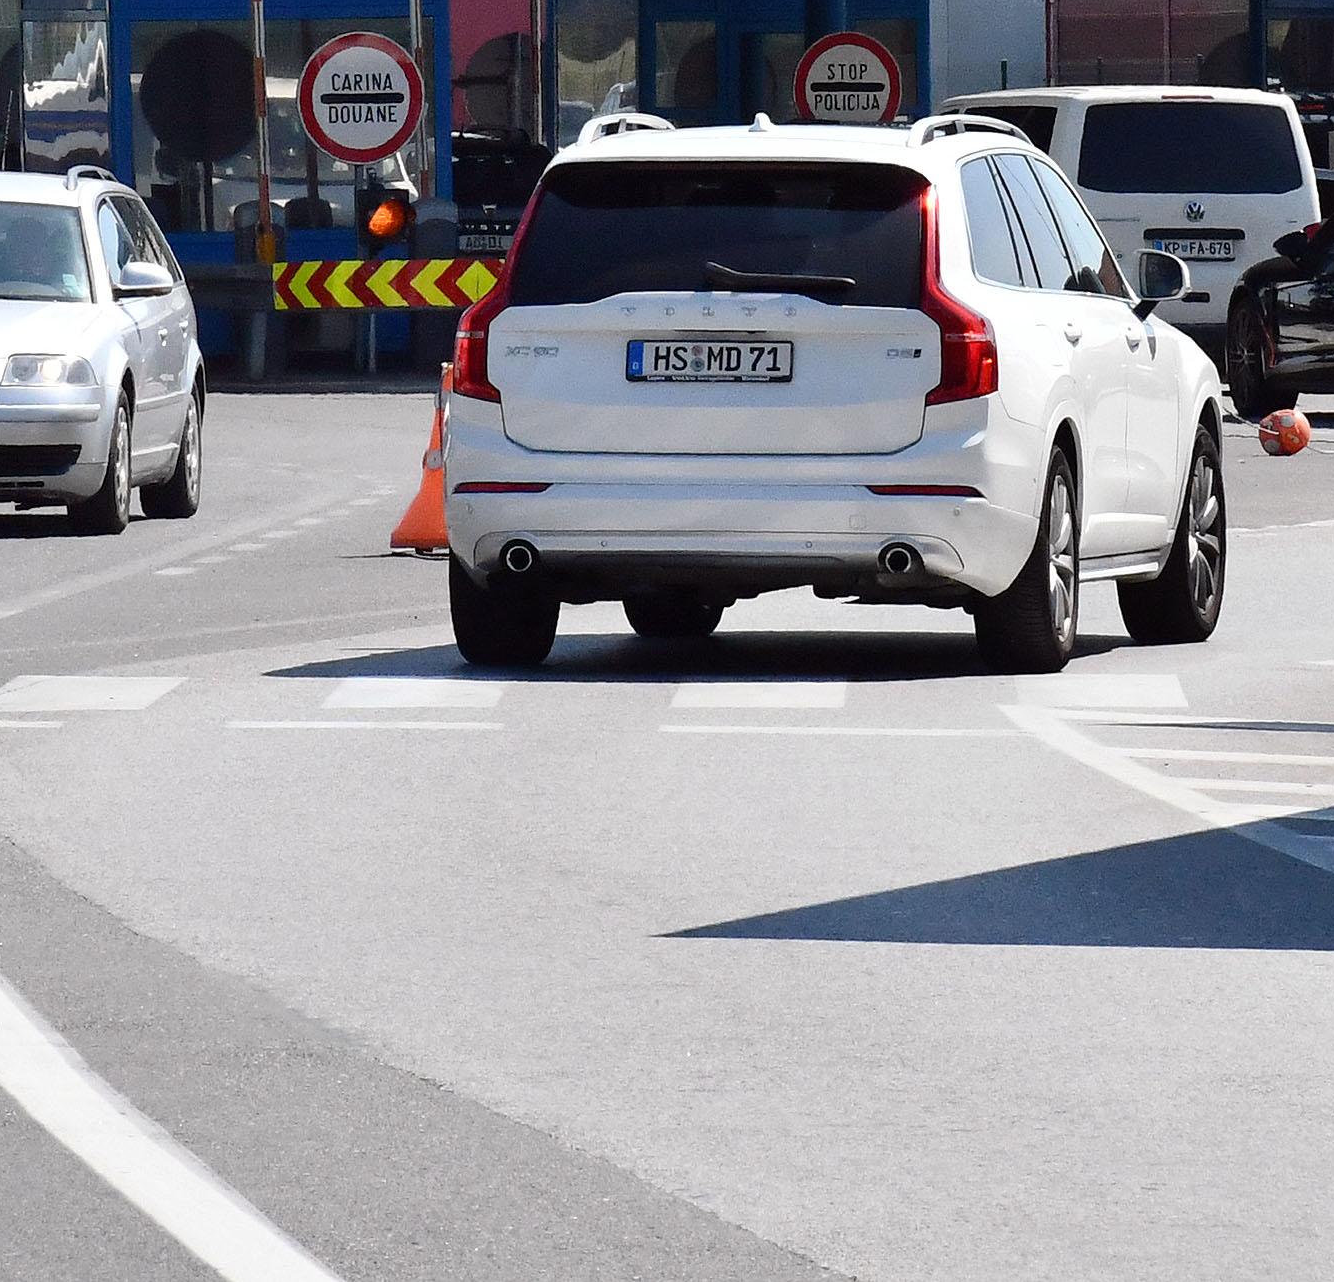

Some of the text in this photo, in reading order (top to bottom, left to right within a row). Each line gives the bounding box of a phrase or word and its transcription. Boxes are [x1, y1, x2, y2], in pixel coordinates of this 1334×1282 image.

[827, 63, 868, 80] STOP
[331, 72, 393, 91] CARINA
[814, 93, 880, 111] POLICIJA
[328, 106, 398, 124] DOUANE
[1164, 242, 1231, 255] KP FA-679
[653, 345, 781, 371] HS MD 71
